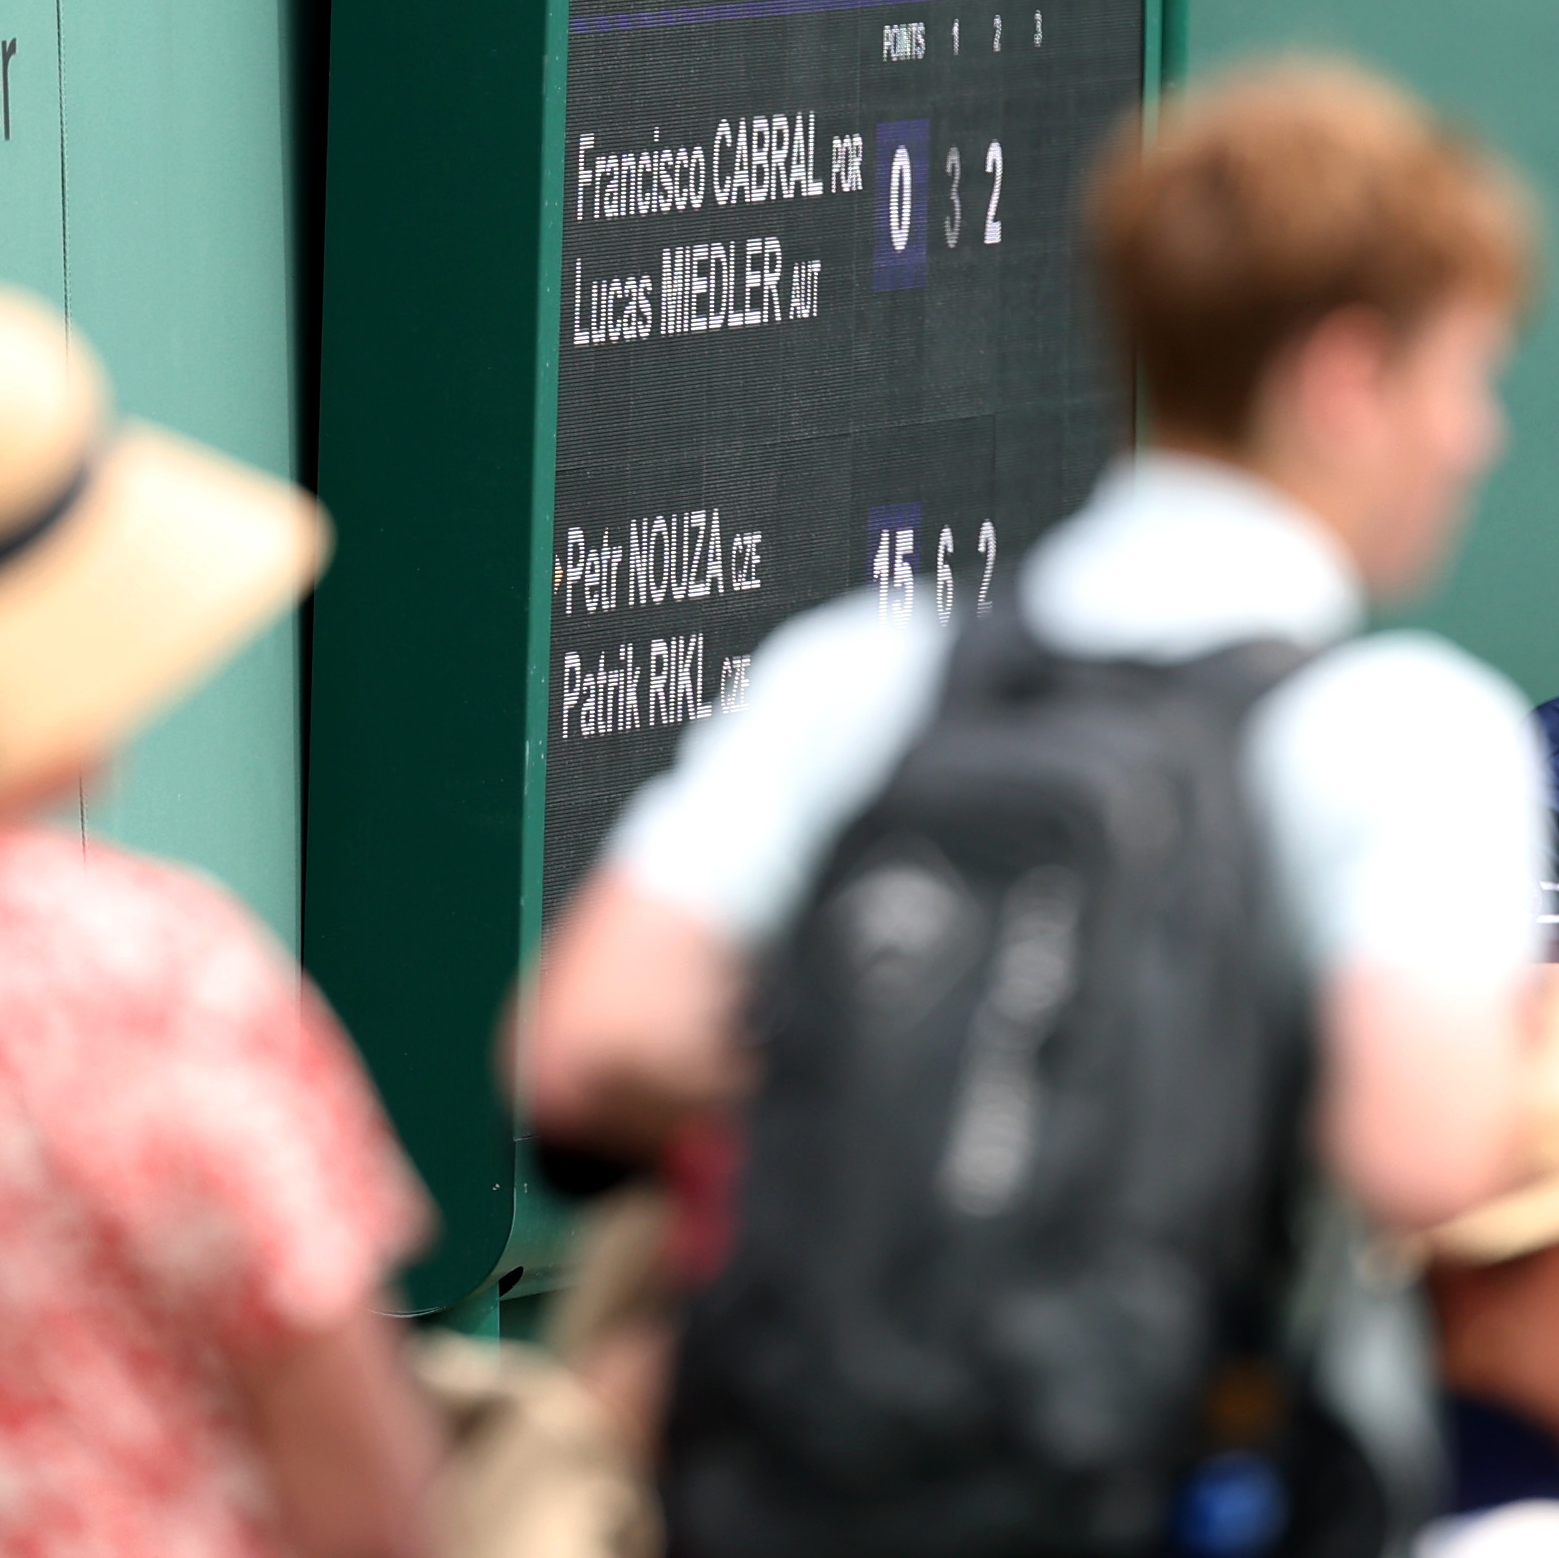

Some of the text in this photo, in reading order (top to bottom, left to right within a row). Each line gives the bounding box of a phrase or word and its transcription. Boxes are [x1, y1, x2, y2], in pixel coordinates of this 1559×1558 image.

[882, 21, 926, 62] POINTS
[951, 18, 960, 56] 1
[992, 13, 1002, 52] 2
[576, 110, 864, 221] Francisco CABRAL POR
[889, 137, 1004, 254] 0 3 2
[573, 236, 822, 345] Lucas MIEDLER AUT
[566, 508, 762, 616] Petr NOUZA CZE
[873, 517, 997, 630] 15 6 2
[562, 632, 751, 740] Patrik RIKL CZE
